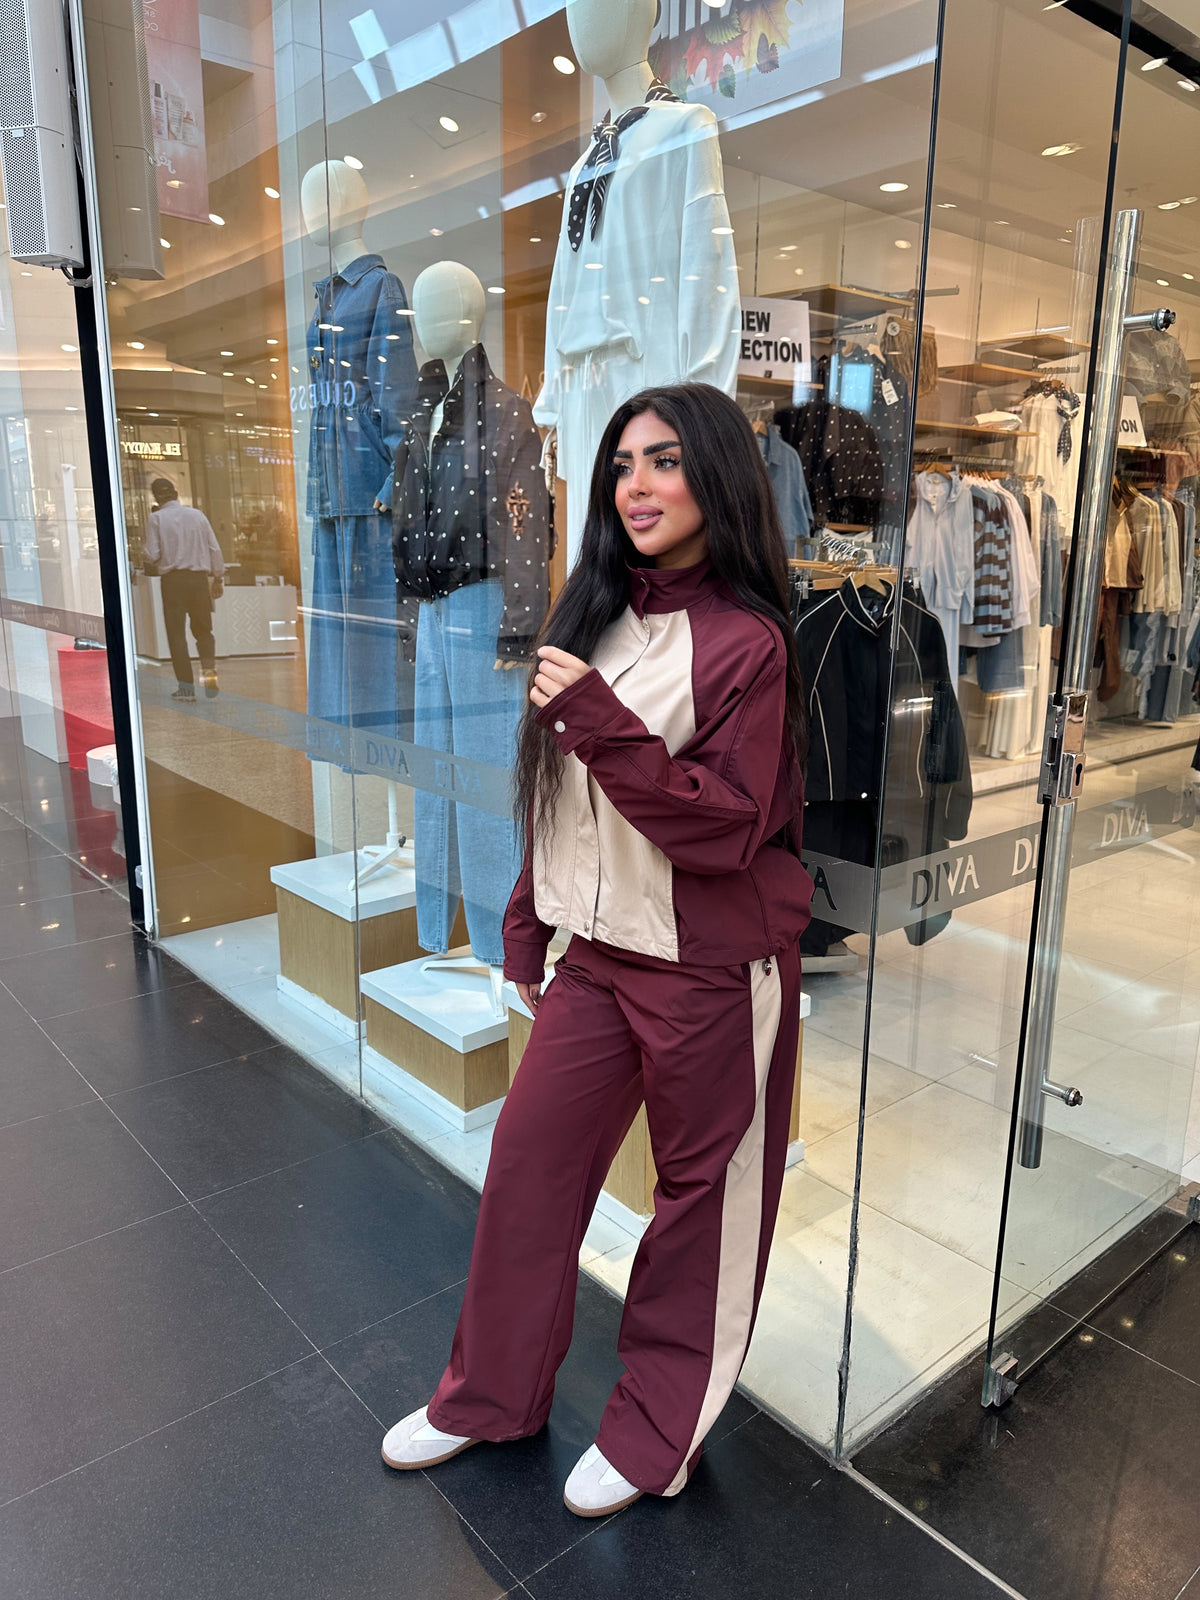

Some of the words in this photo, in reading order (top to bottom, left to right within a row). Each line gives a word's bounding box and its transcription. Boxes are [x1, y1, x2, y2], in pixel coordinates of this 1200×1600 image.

[740, 339, 803, 363] ECTION
[1120, 419, 1138, 433] ON
[306, 722, 345, 757] DIVA
[366, 740, 412, 778] DIVA
[434, 759, 485, 797] DIVA
[1101, 802, 1150, 848] DIVA
[910, 854, 980, 911] DIVA
